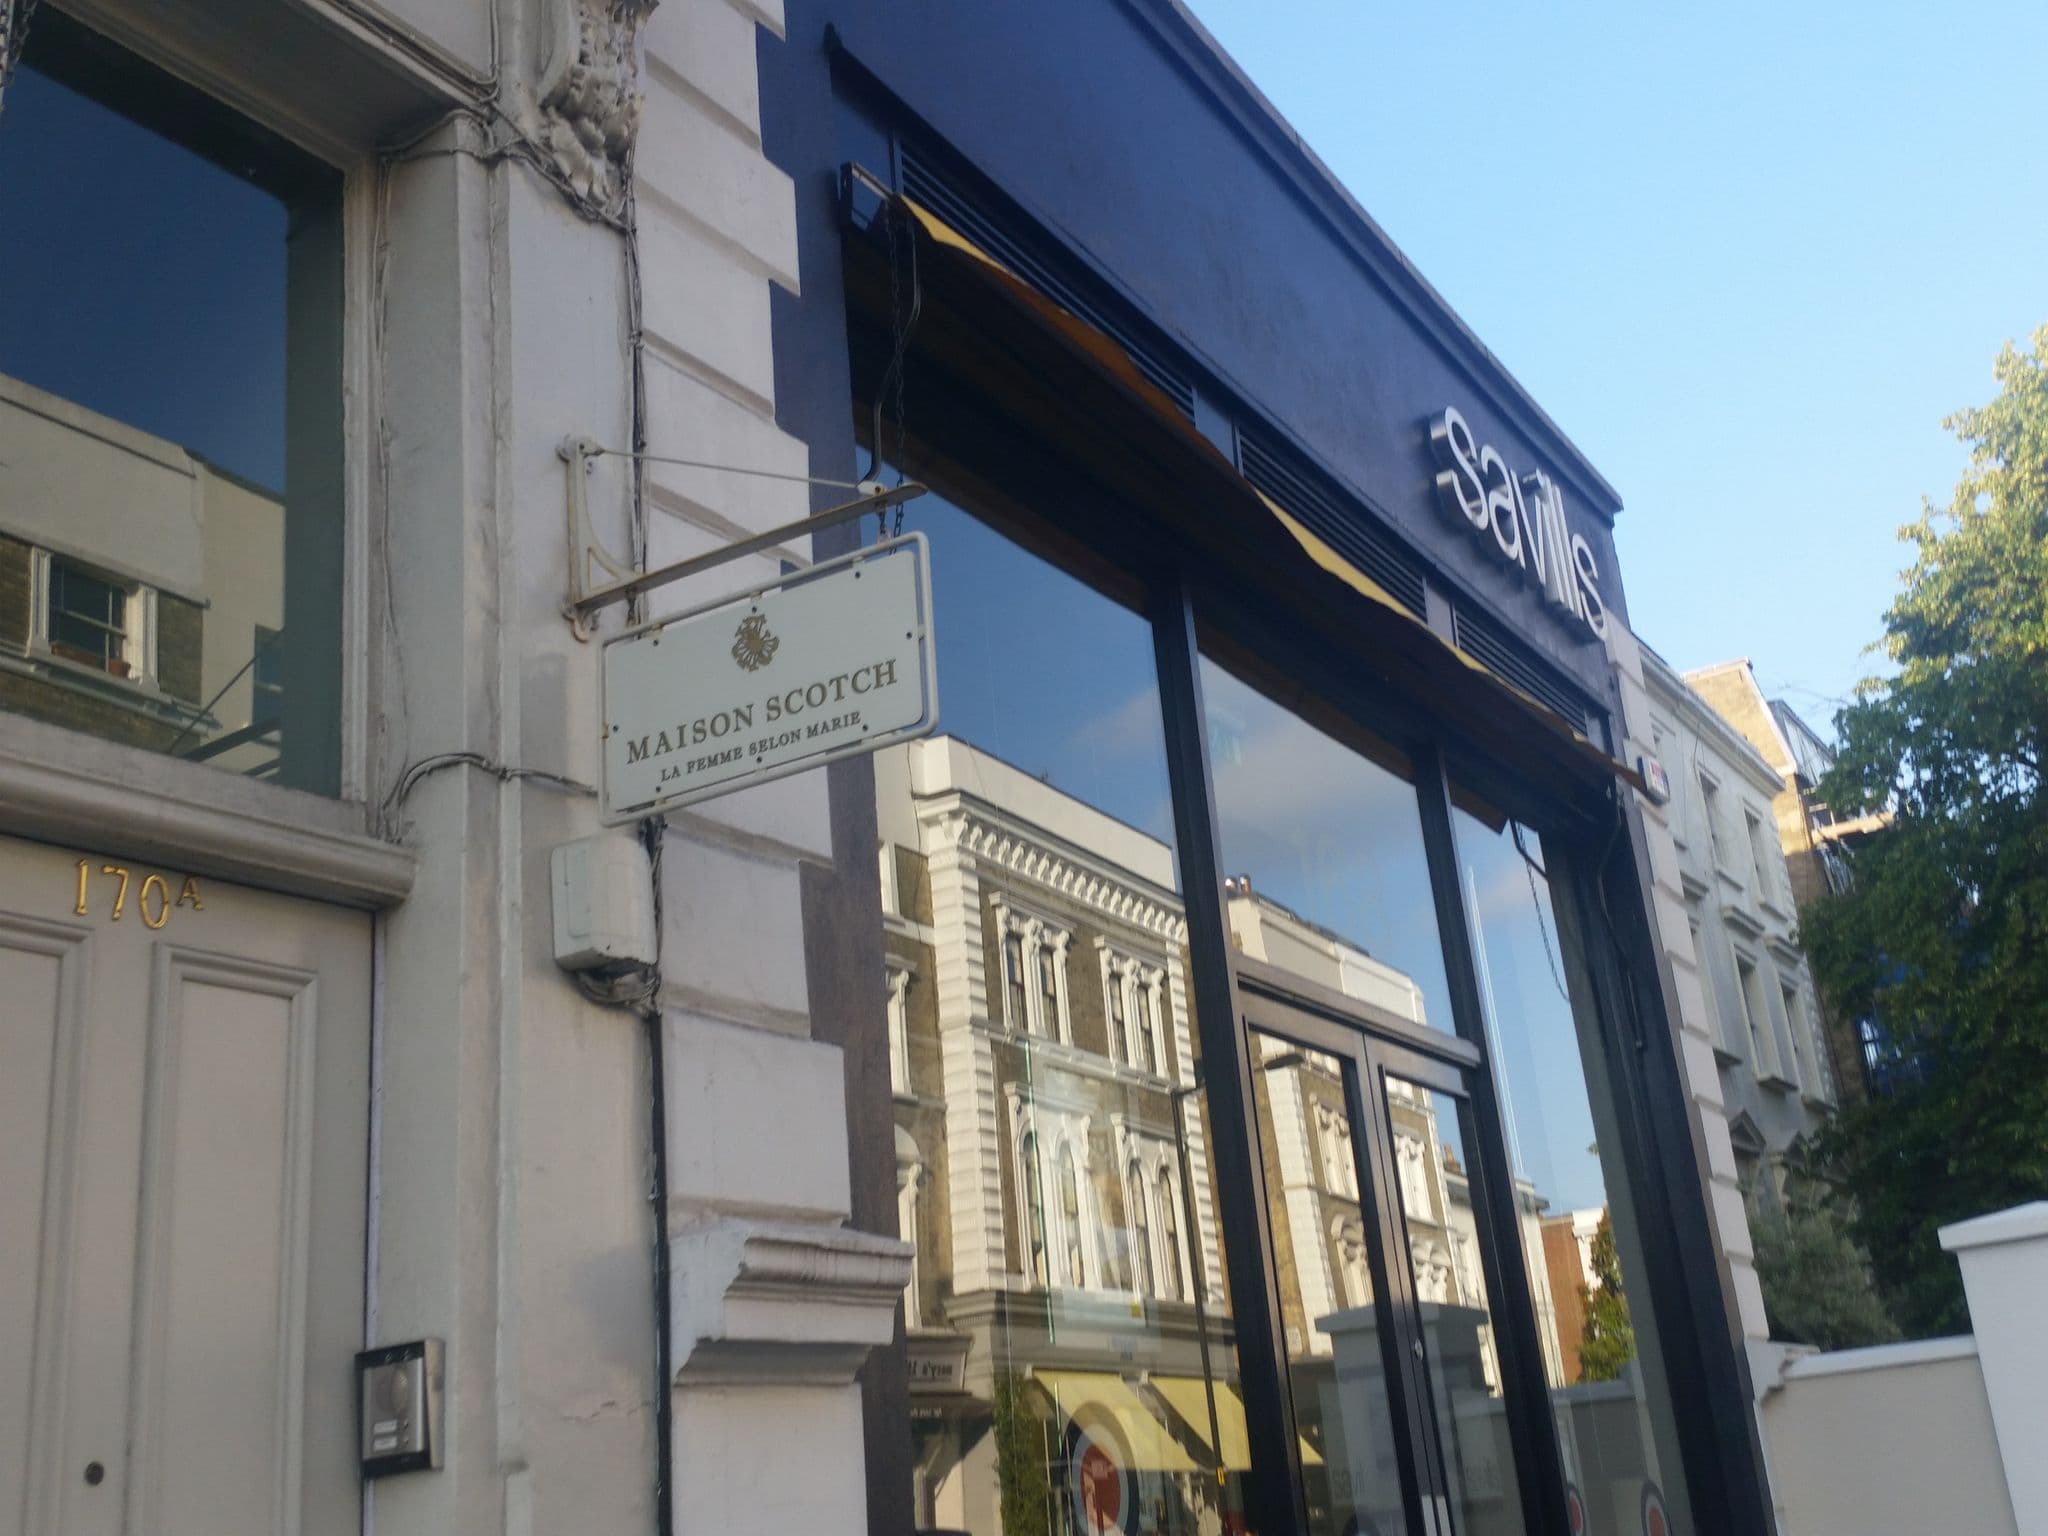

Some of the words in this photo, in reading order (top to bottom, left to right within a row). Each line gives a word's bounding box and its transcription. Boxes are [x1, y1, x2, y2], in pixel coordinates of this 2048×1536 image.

[627, 704, 754, 765] MAISON
[766, 658, 898, 723] SCOTCH
[660, 766, 682, 782] LA
[686, 747, 744, 775] FEMME
[748, 728, 802, 758] SELON
[806, 711, 862, 740] MARIE
